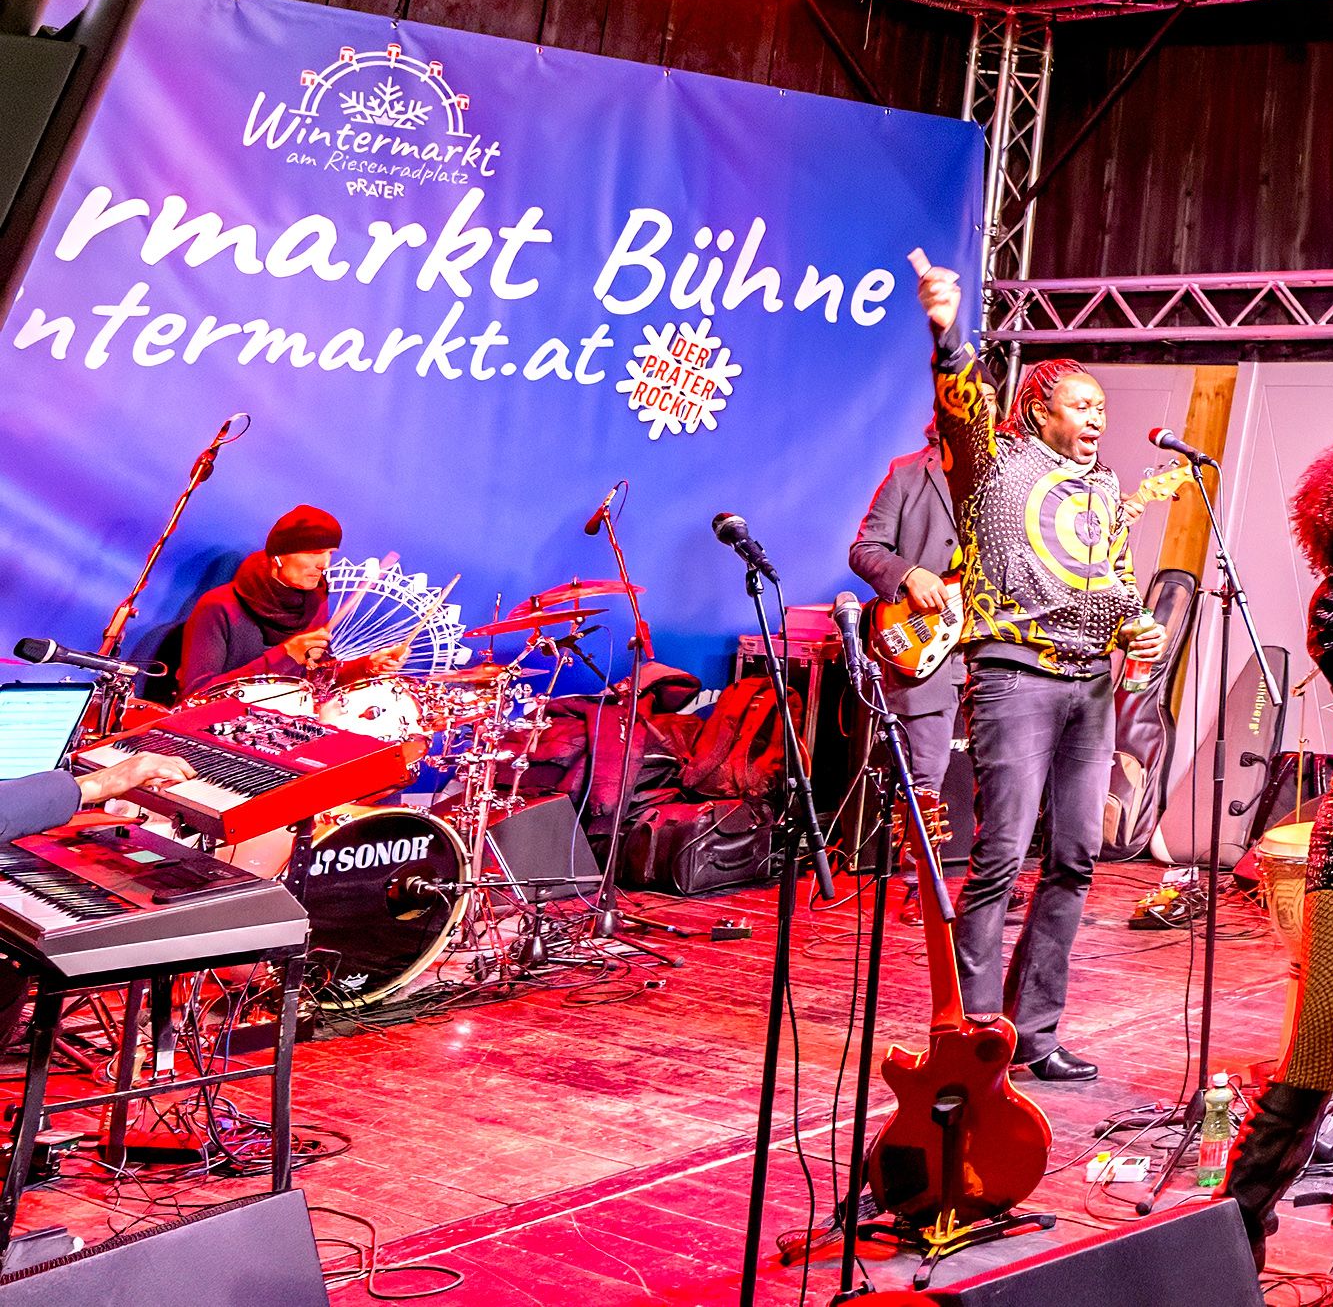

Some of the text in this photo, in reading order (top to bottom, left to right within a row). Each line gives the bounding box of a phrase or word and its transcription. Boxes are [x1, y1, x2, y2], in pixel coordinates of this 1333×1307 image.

[242, 91, 501, 178] Wintermarkt
[286, 149, 470, 186] am Riesenradplatz
[345, 177, 406, 199] PRATER
[593, 207, 895, 326] Bühne
[13, 282, 614, 385] ntermarkt.at
[671, 337, 710, 368] DER
[642, 354, 716, 401] PRATER
[632, 380, 703, 424] ROCKT!
[336, 835, 431, 873] SONOR
